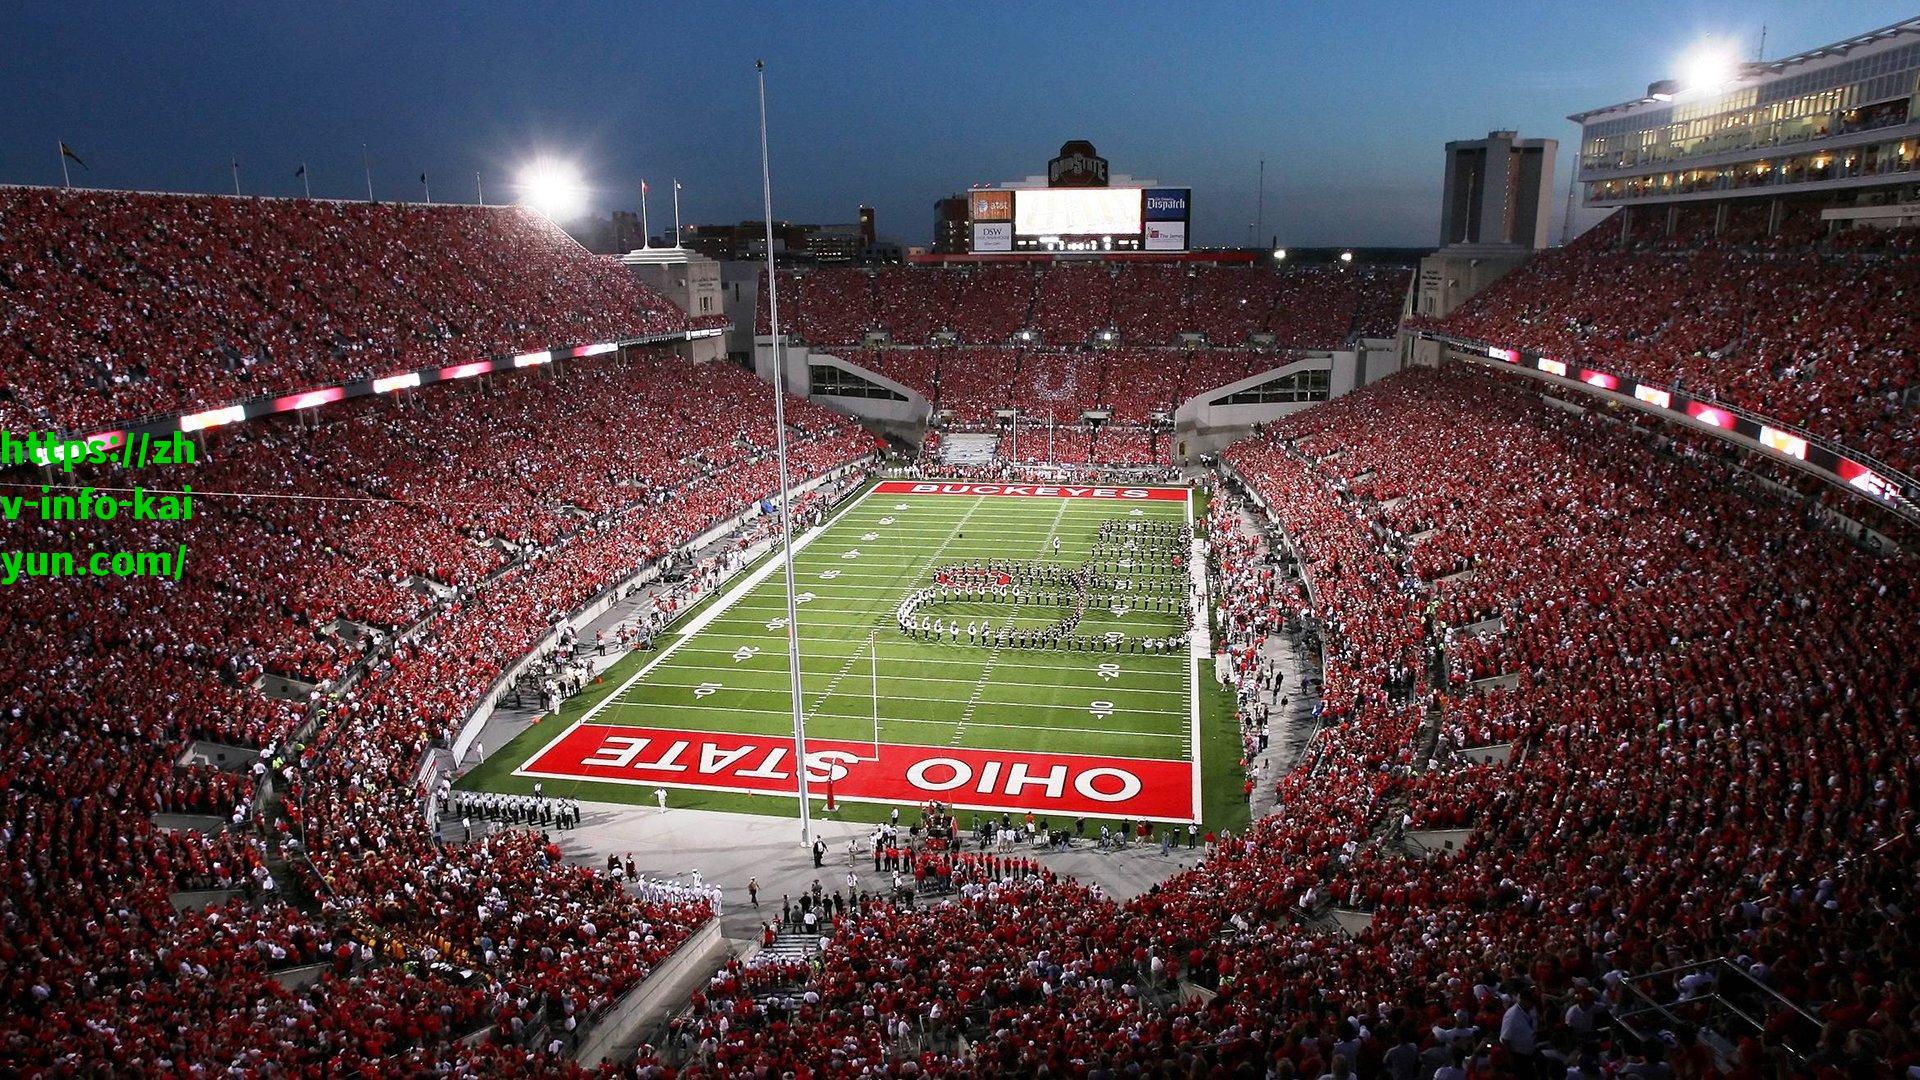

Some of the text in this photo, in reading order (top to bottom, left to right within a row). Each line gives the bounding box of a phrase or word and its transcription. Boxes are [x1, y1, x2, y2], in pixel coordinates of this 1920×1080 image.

[1147, 197, 1186, 211] Dispatch
[983, 228, 1002, 236] DSW
[911, 484, 1149, 499] BUCKEYES
[1089, 701, 1114, 714] 10
[580, 736, 1142, 802] OHIO STATE
